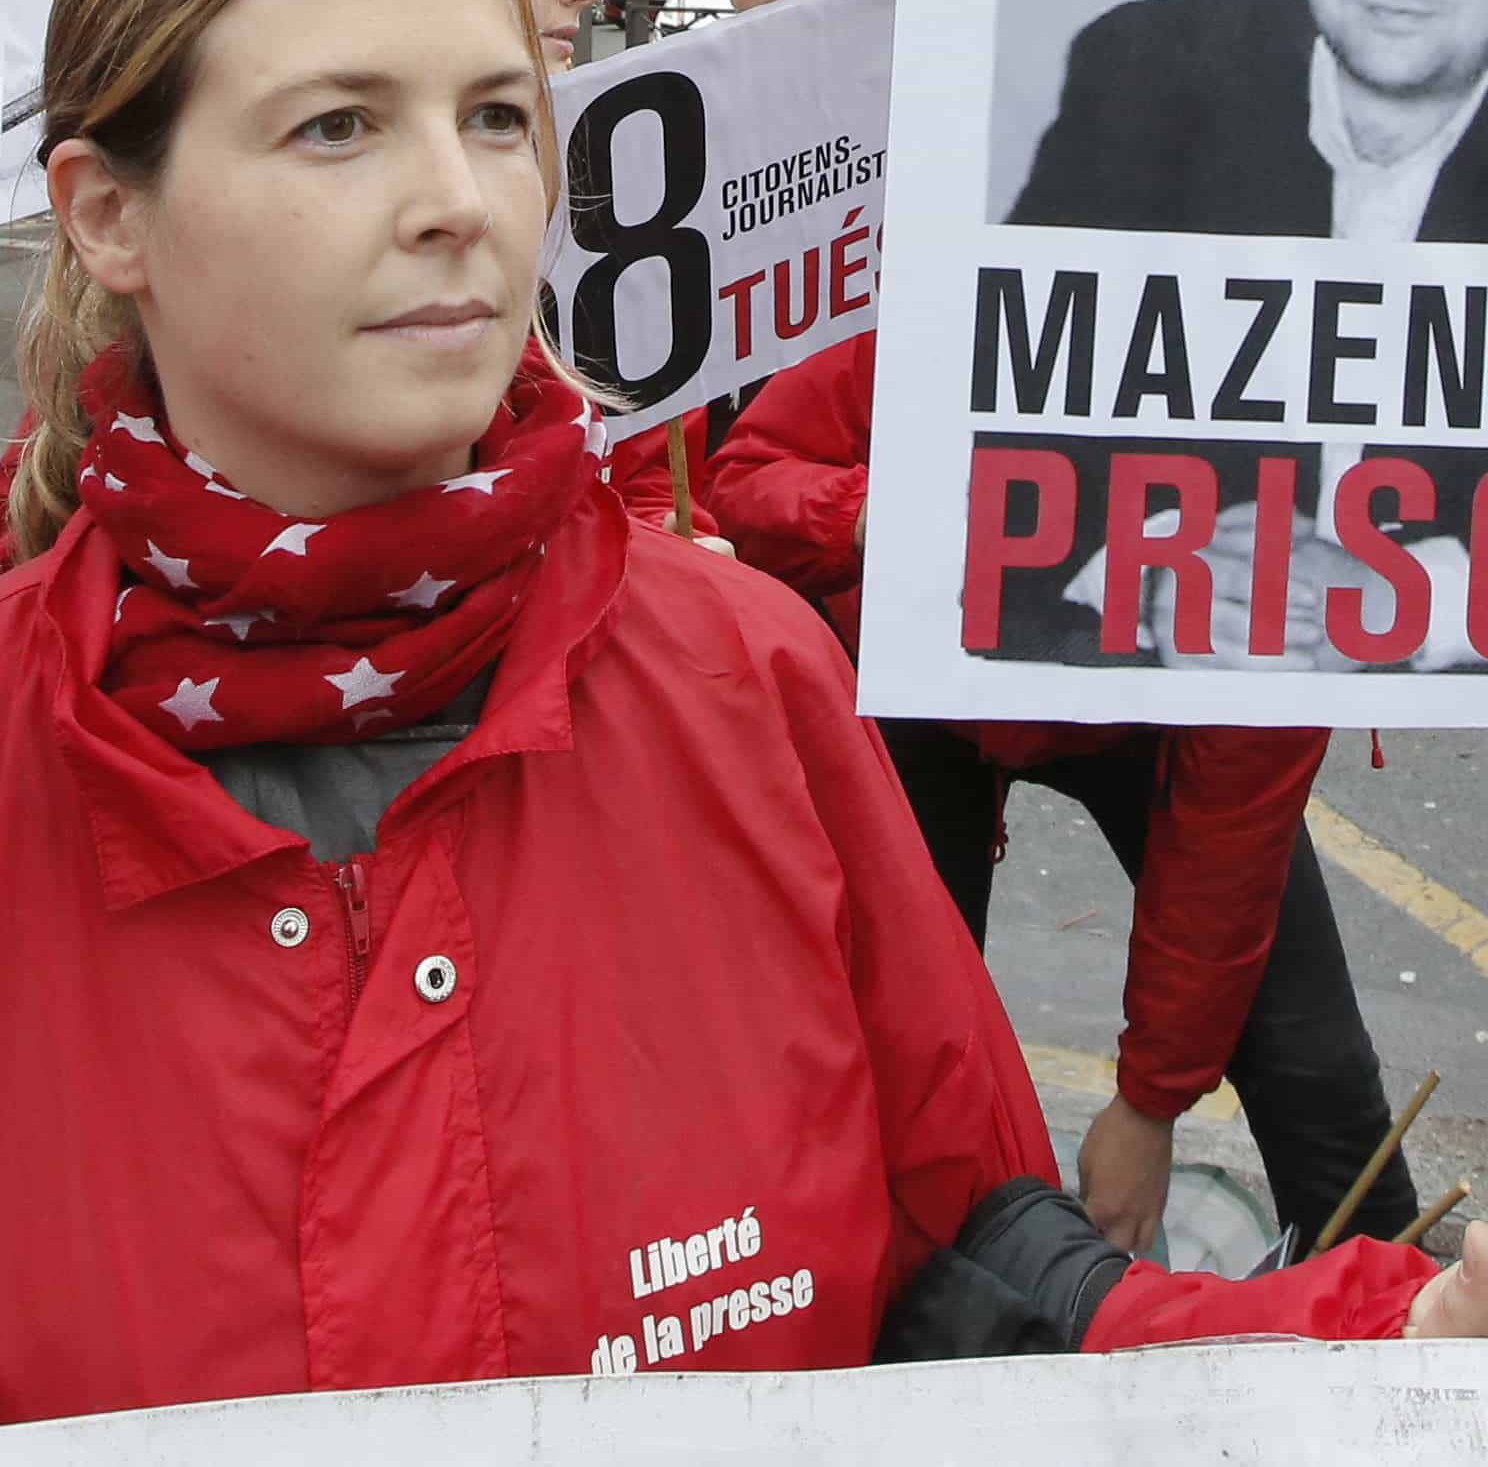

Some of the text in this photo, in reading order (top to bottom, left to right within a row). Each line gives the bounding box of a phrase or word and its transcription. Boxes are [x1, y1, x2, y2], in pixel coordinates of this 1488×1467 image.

[721, 136, 862, 210] CITOYENS-
[722, 150, 886, 241] JOURNALIST
[536, 71, 712, 417] 8
[970, 267, 1488, 429] MAZEN
[629, 1206, 762, 1300] Liberté
[591, 1268, 814, 1374] de la presse
